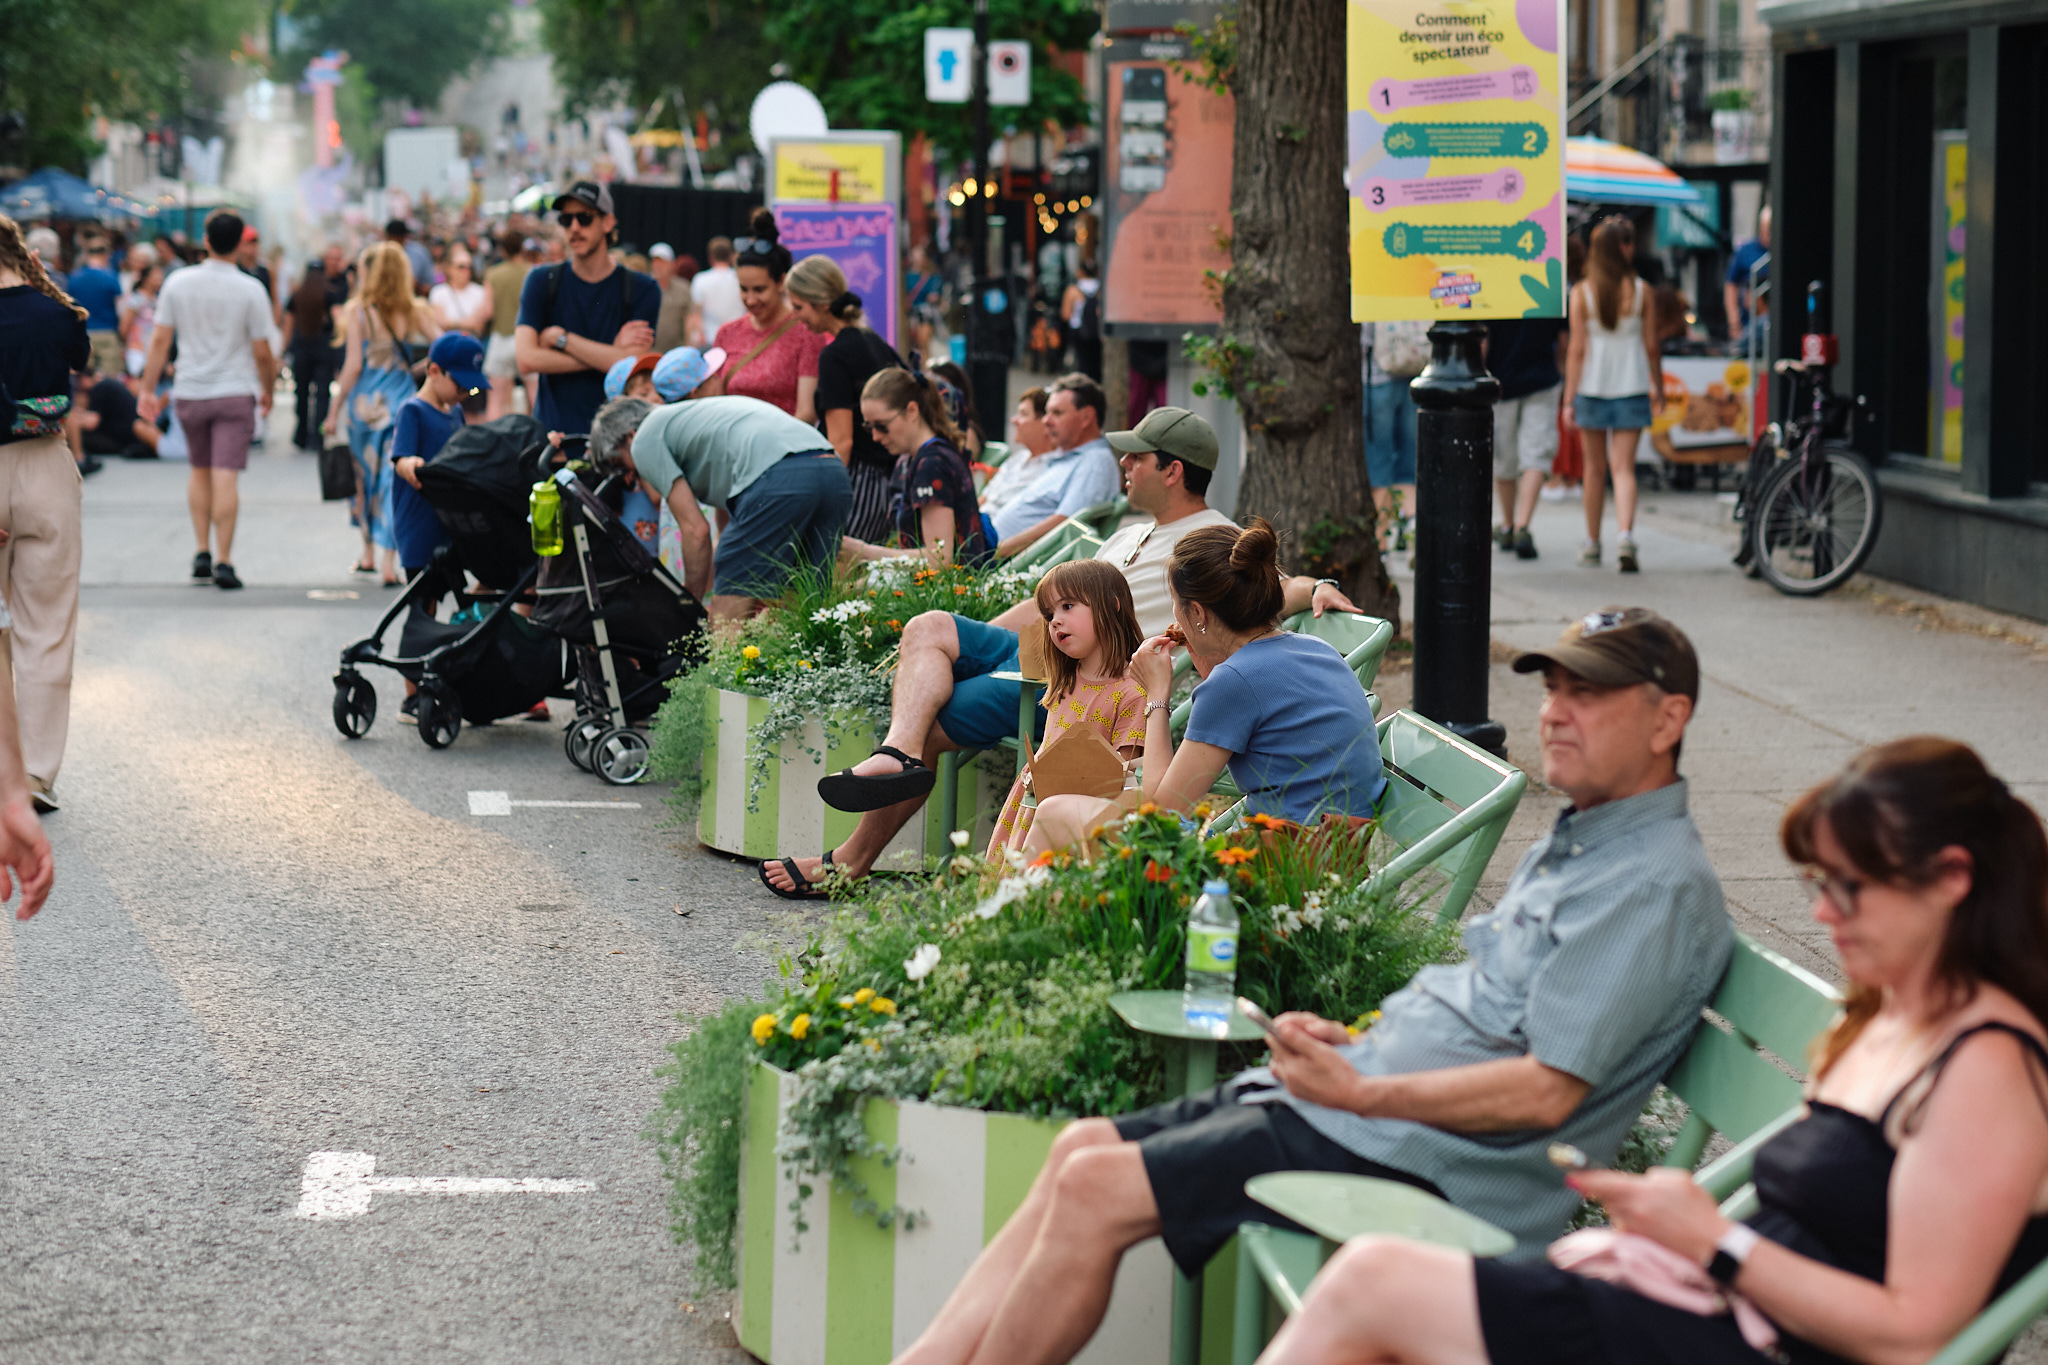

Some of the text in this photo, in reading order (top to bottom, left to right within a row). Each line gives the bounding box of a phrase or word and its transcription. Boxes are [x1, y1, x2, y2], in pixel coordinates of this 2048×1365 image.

[1416, 13, 1487, 27] Comment
[1399, 29, 1504, 43] devenir un éco
[1412, 45, 1491, 64] spectateur
[1380, 88, 1390, 107] 1
[1522, 131, 1537, 152] 2
[1371, 186, 1386, 206] 3
[1517, 230, 1535, 253] 4
